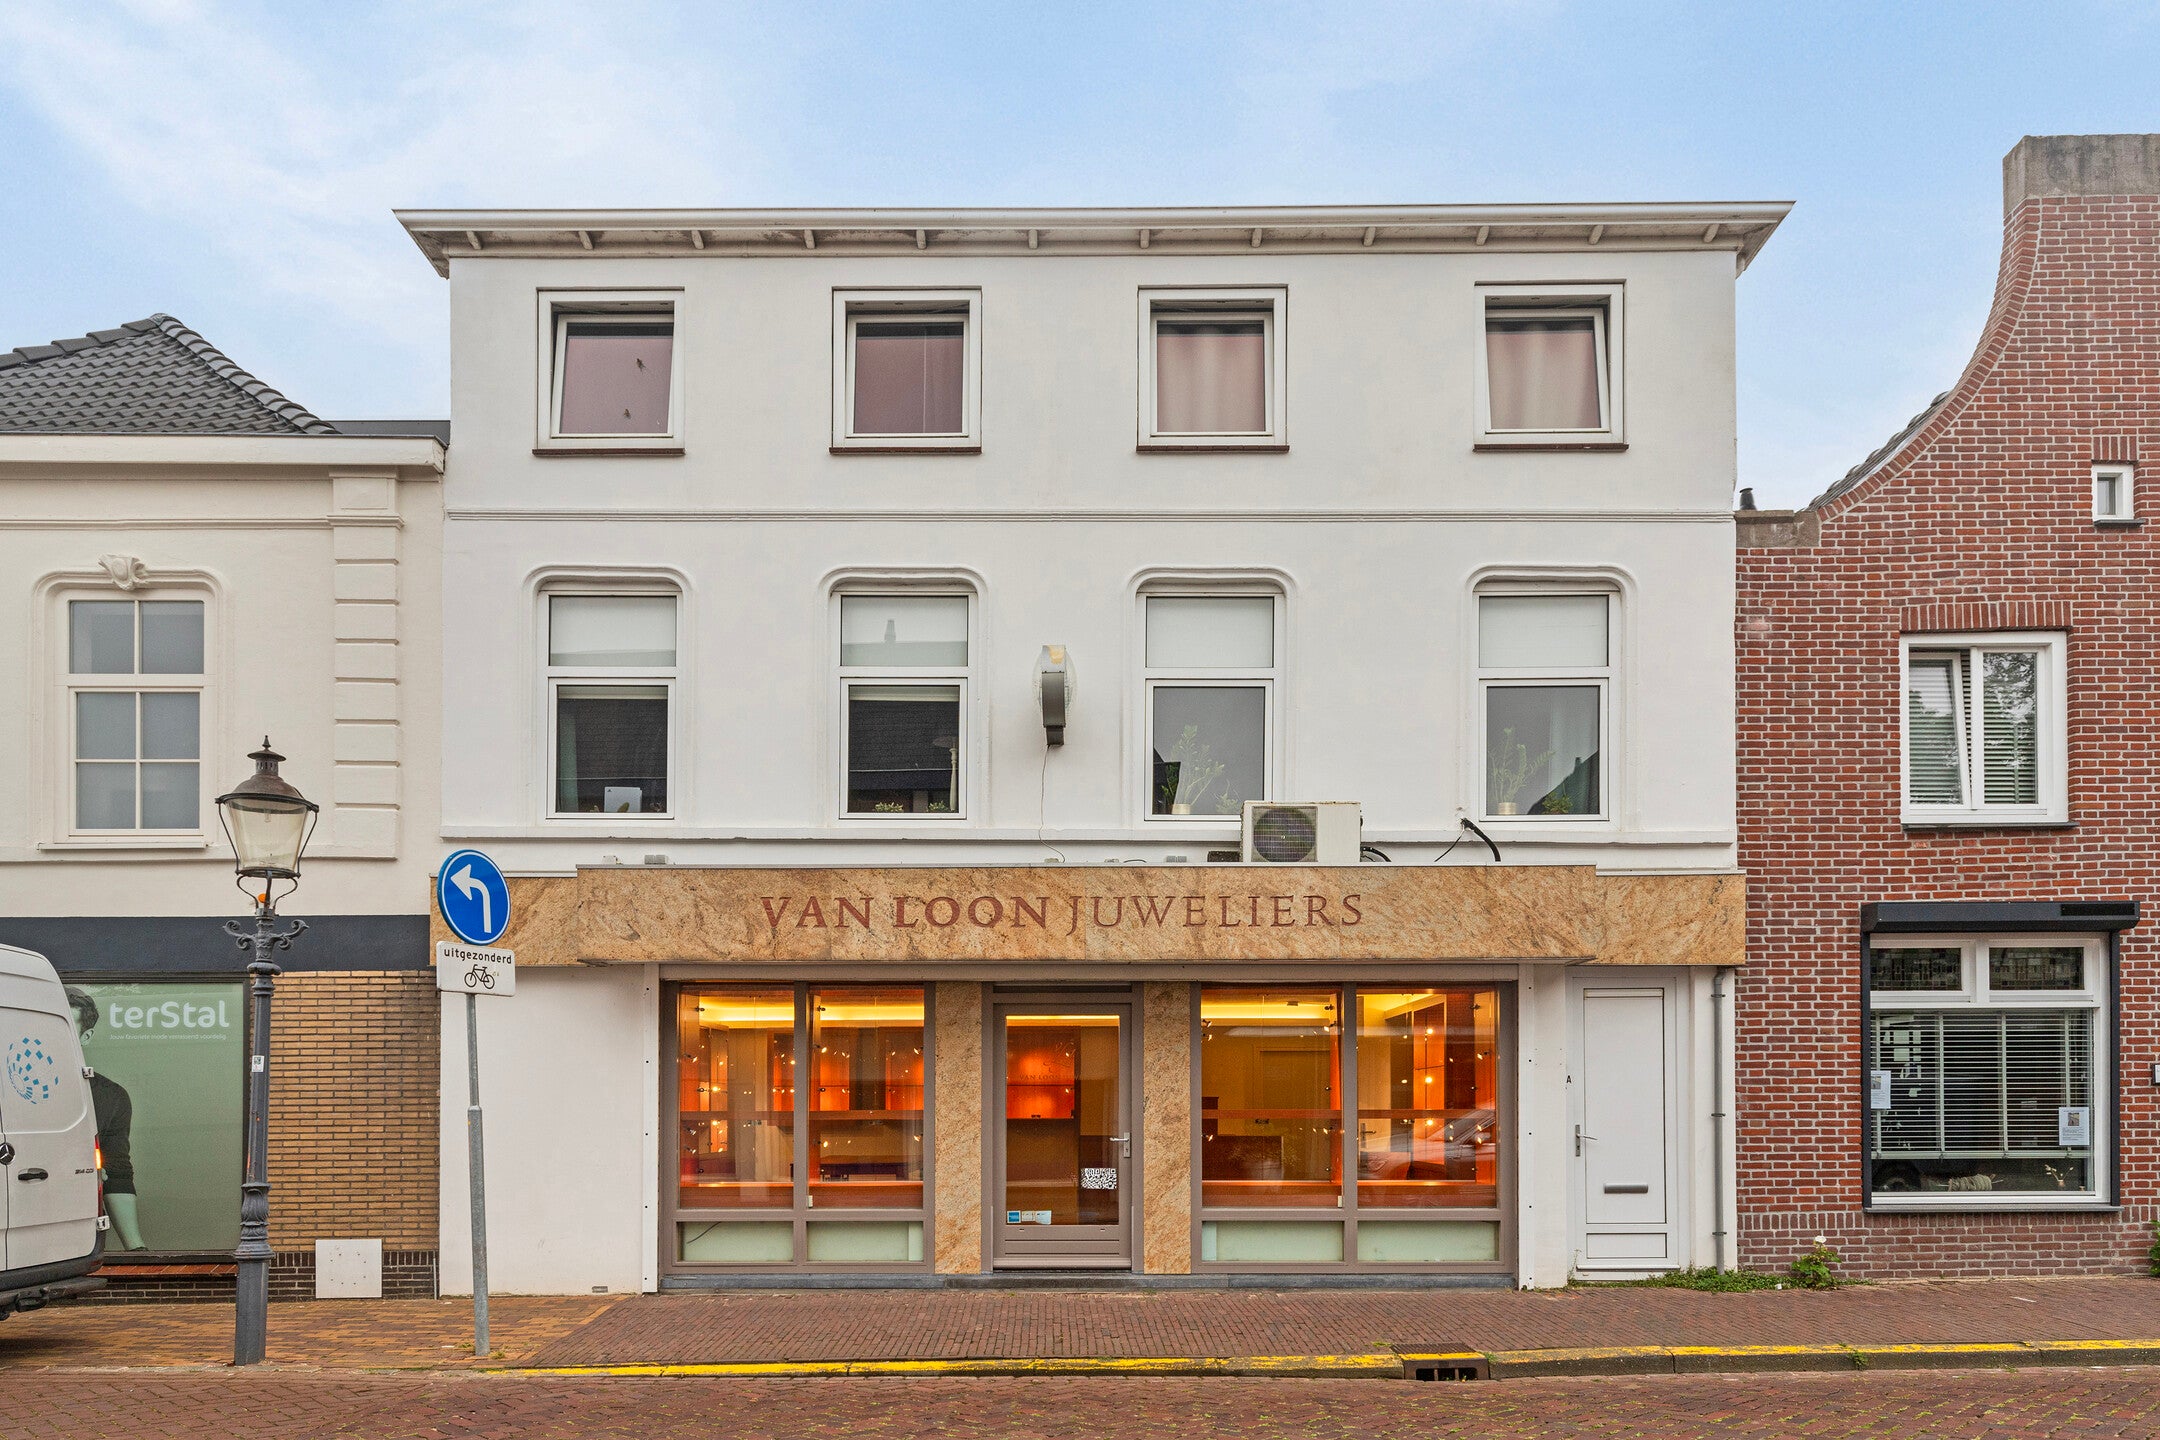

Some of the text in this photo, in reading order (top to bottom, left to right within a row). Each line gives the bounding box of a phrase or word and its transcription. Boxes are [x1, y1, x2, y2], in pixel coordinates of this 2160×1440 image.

[760, 894, 1362, 936] VAN LOON JUWELIERS
[444, 947, 512, 964] uitgezonderd
[109, 1000, 230, 1029] terStal
